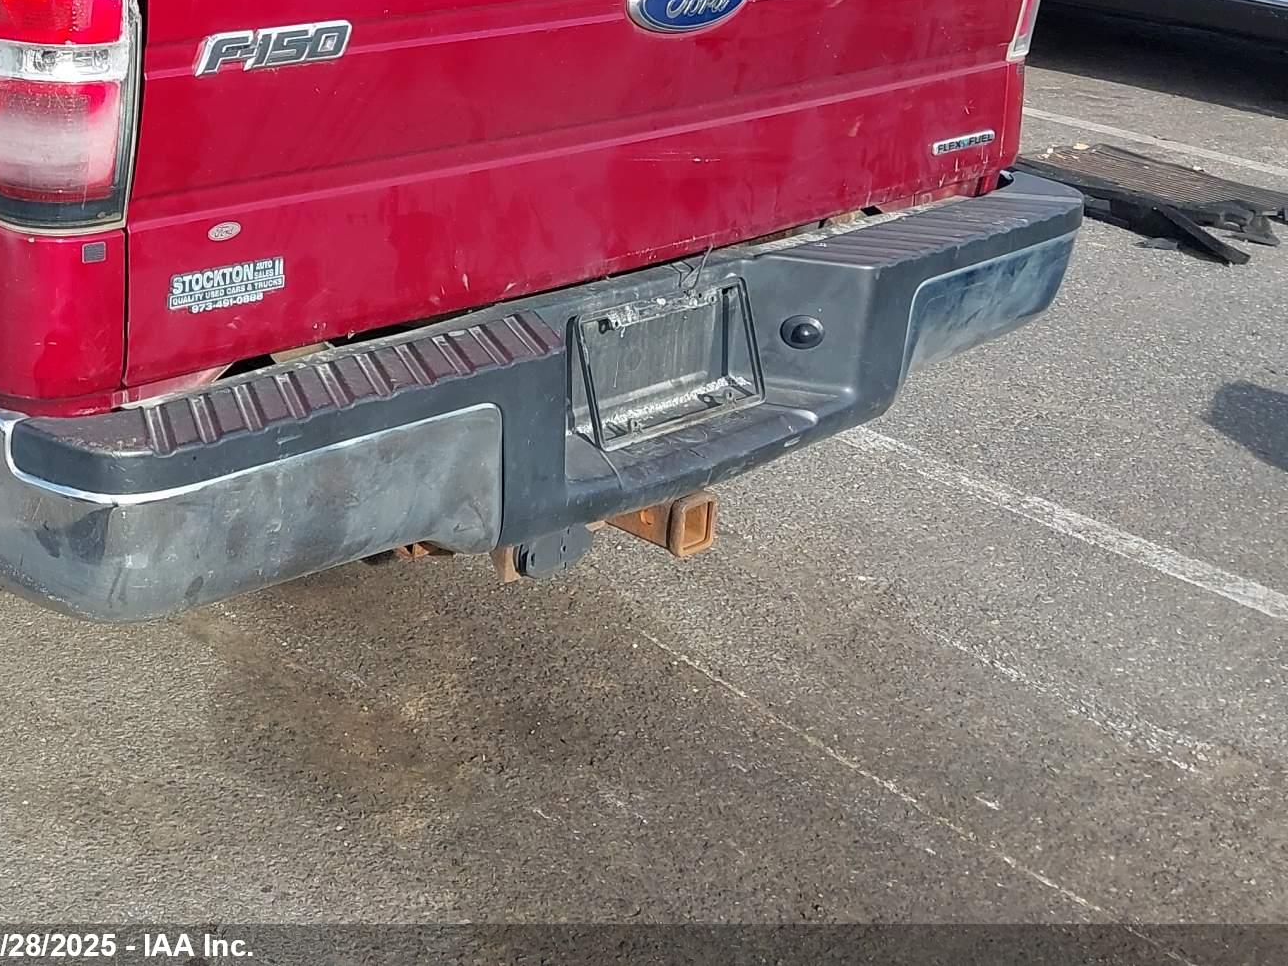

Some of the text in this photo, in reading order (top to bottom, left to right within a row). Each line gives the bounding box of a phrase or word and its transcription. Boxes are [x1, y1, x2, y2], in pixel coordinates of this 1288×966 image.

[194, 19, 353, 78] F-150
[936, 133, 994, 154] FLEX FUEL
[254, 268, 274, 280] SALES
[255, 259, 273, 271] AUTO
[172, 262, 254, 295] STOCKTON
[172, 277, 283, 306] QUALITY USED CARS & TRUCKS
